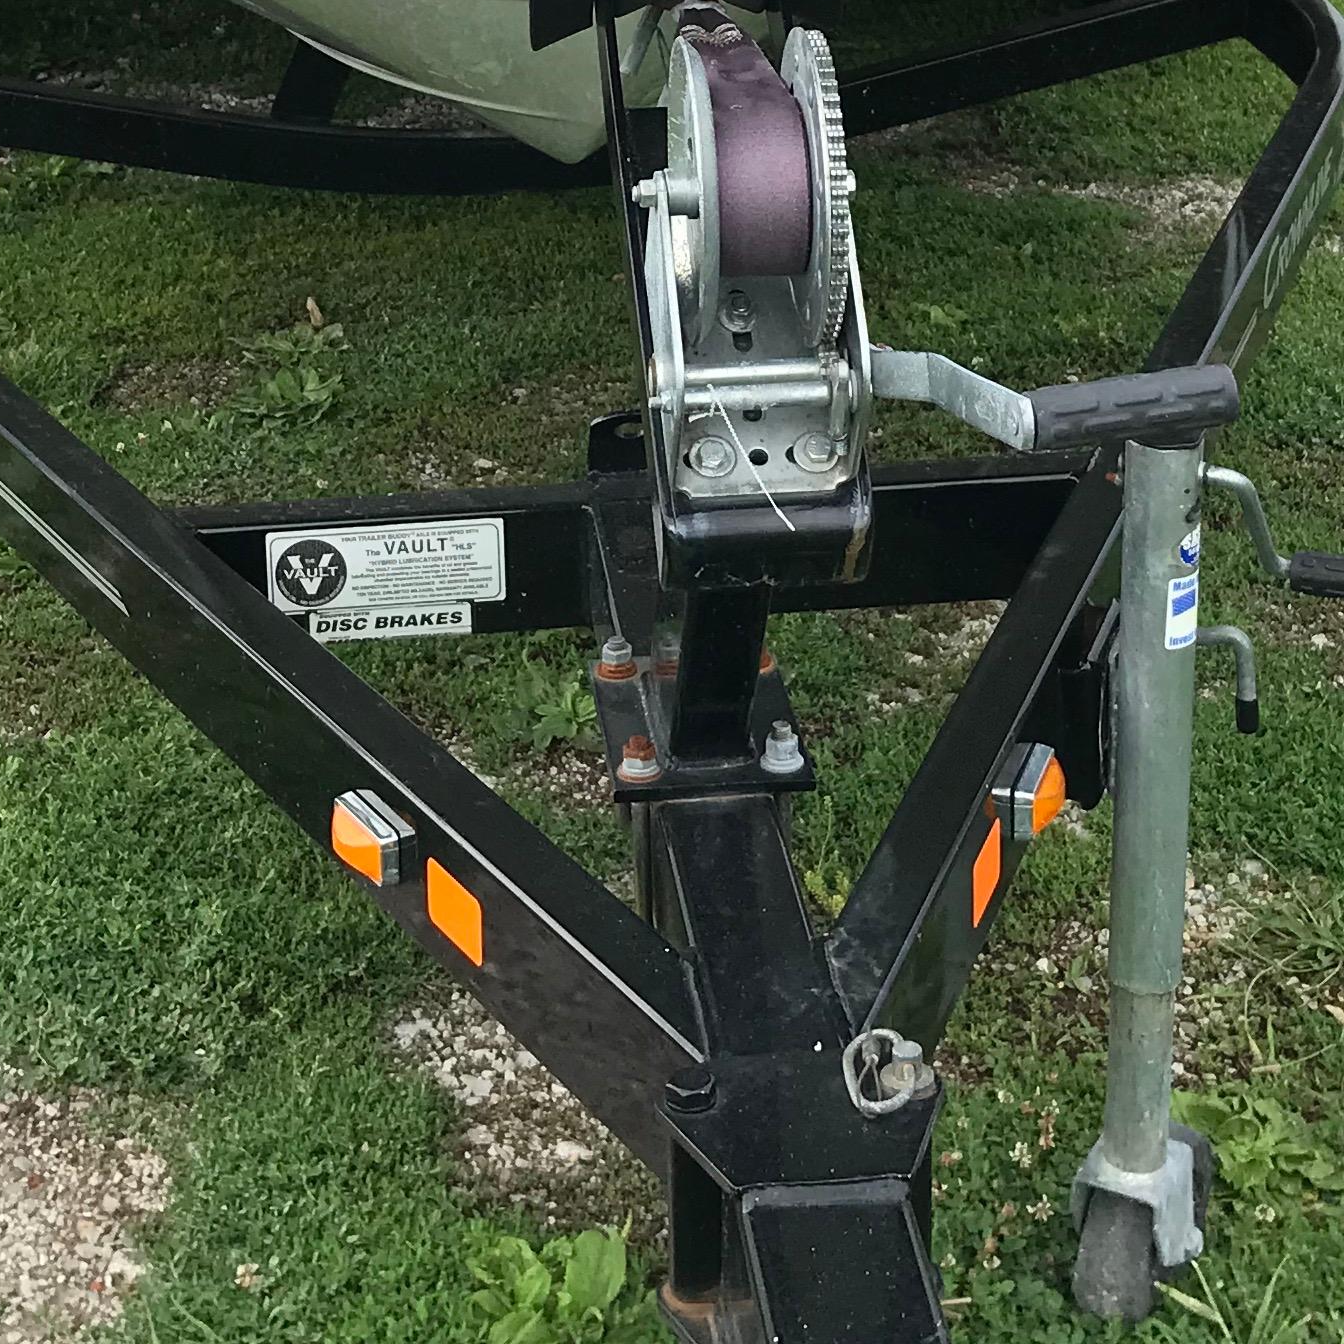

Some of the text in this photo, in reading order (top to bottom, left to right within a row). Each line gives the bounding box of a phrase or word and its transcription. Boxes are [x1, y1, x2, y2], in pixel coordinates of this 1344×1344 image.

[283, 566, 338, 580] VAULT
[316, 611, 463, 633] DISC BRAKES
